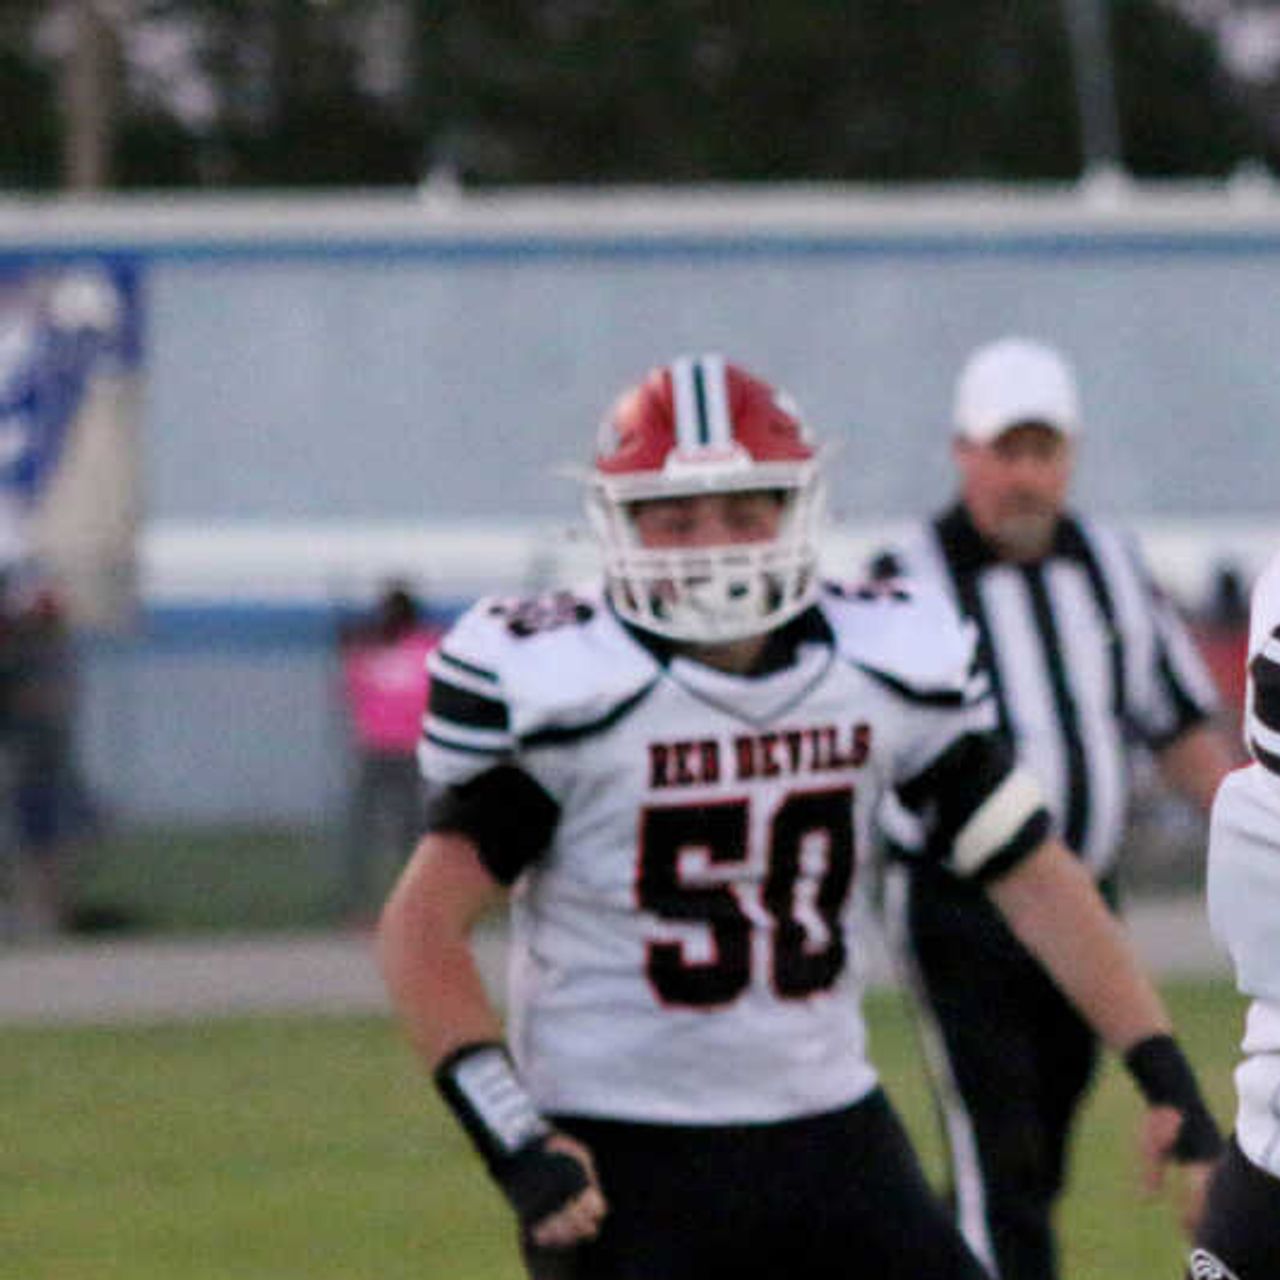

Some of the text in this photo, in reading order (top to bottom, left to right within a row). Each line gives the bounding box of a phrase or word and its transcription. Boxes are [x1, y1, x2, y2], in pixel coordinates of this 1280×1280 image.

[649, 724, 871, 788] RED DEVILS
[635, 784, 856, 1011] 50
